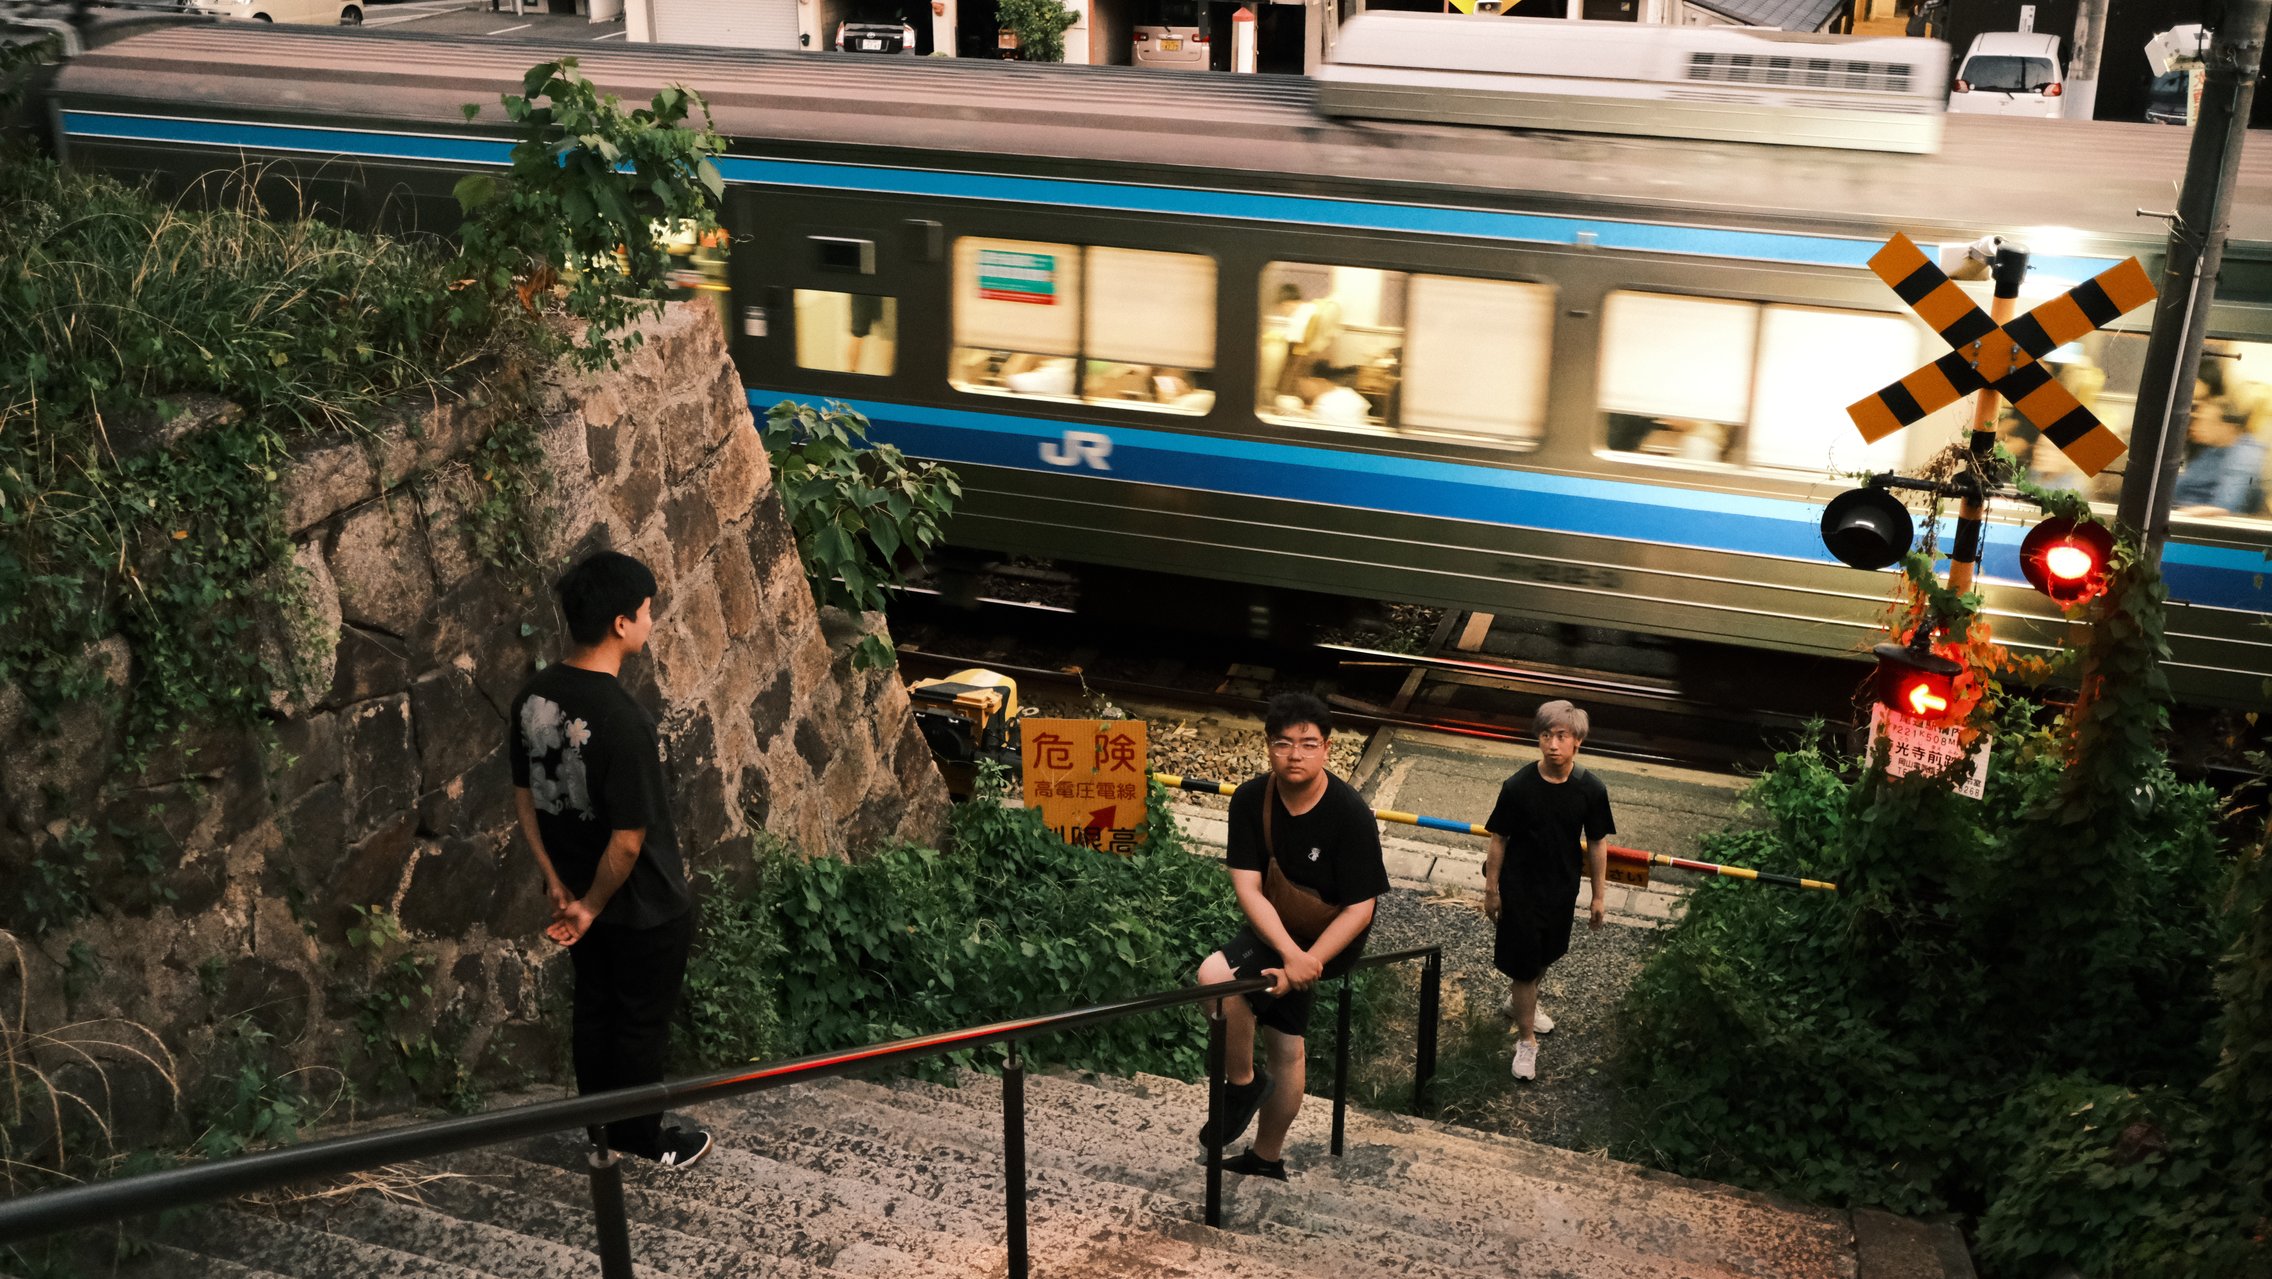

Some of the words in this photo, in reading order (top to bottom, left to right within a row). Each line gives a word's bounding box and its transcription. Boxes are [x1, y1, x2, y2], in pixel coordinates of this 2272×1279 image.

[1038, 430, 1113, 470] JR
[1032, 732, 1136, 773] 危険
[1034, 781, 1136, 800] 高電圧電線
[1048, 825, 1138, 853] 限高
[660, 1151, 677, 1165] N
